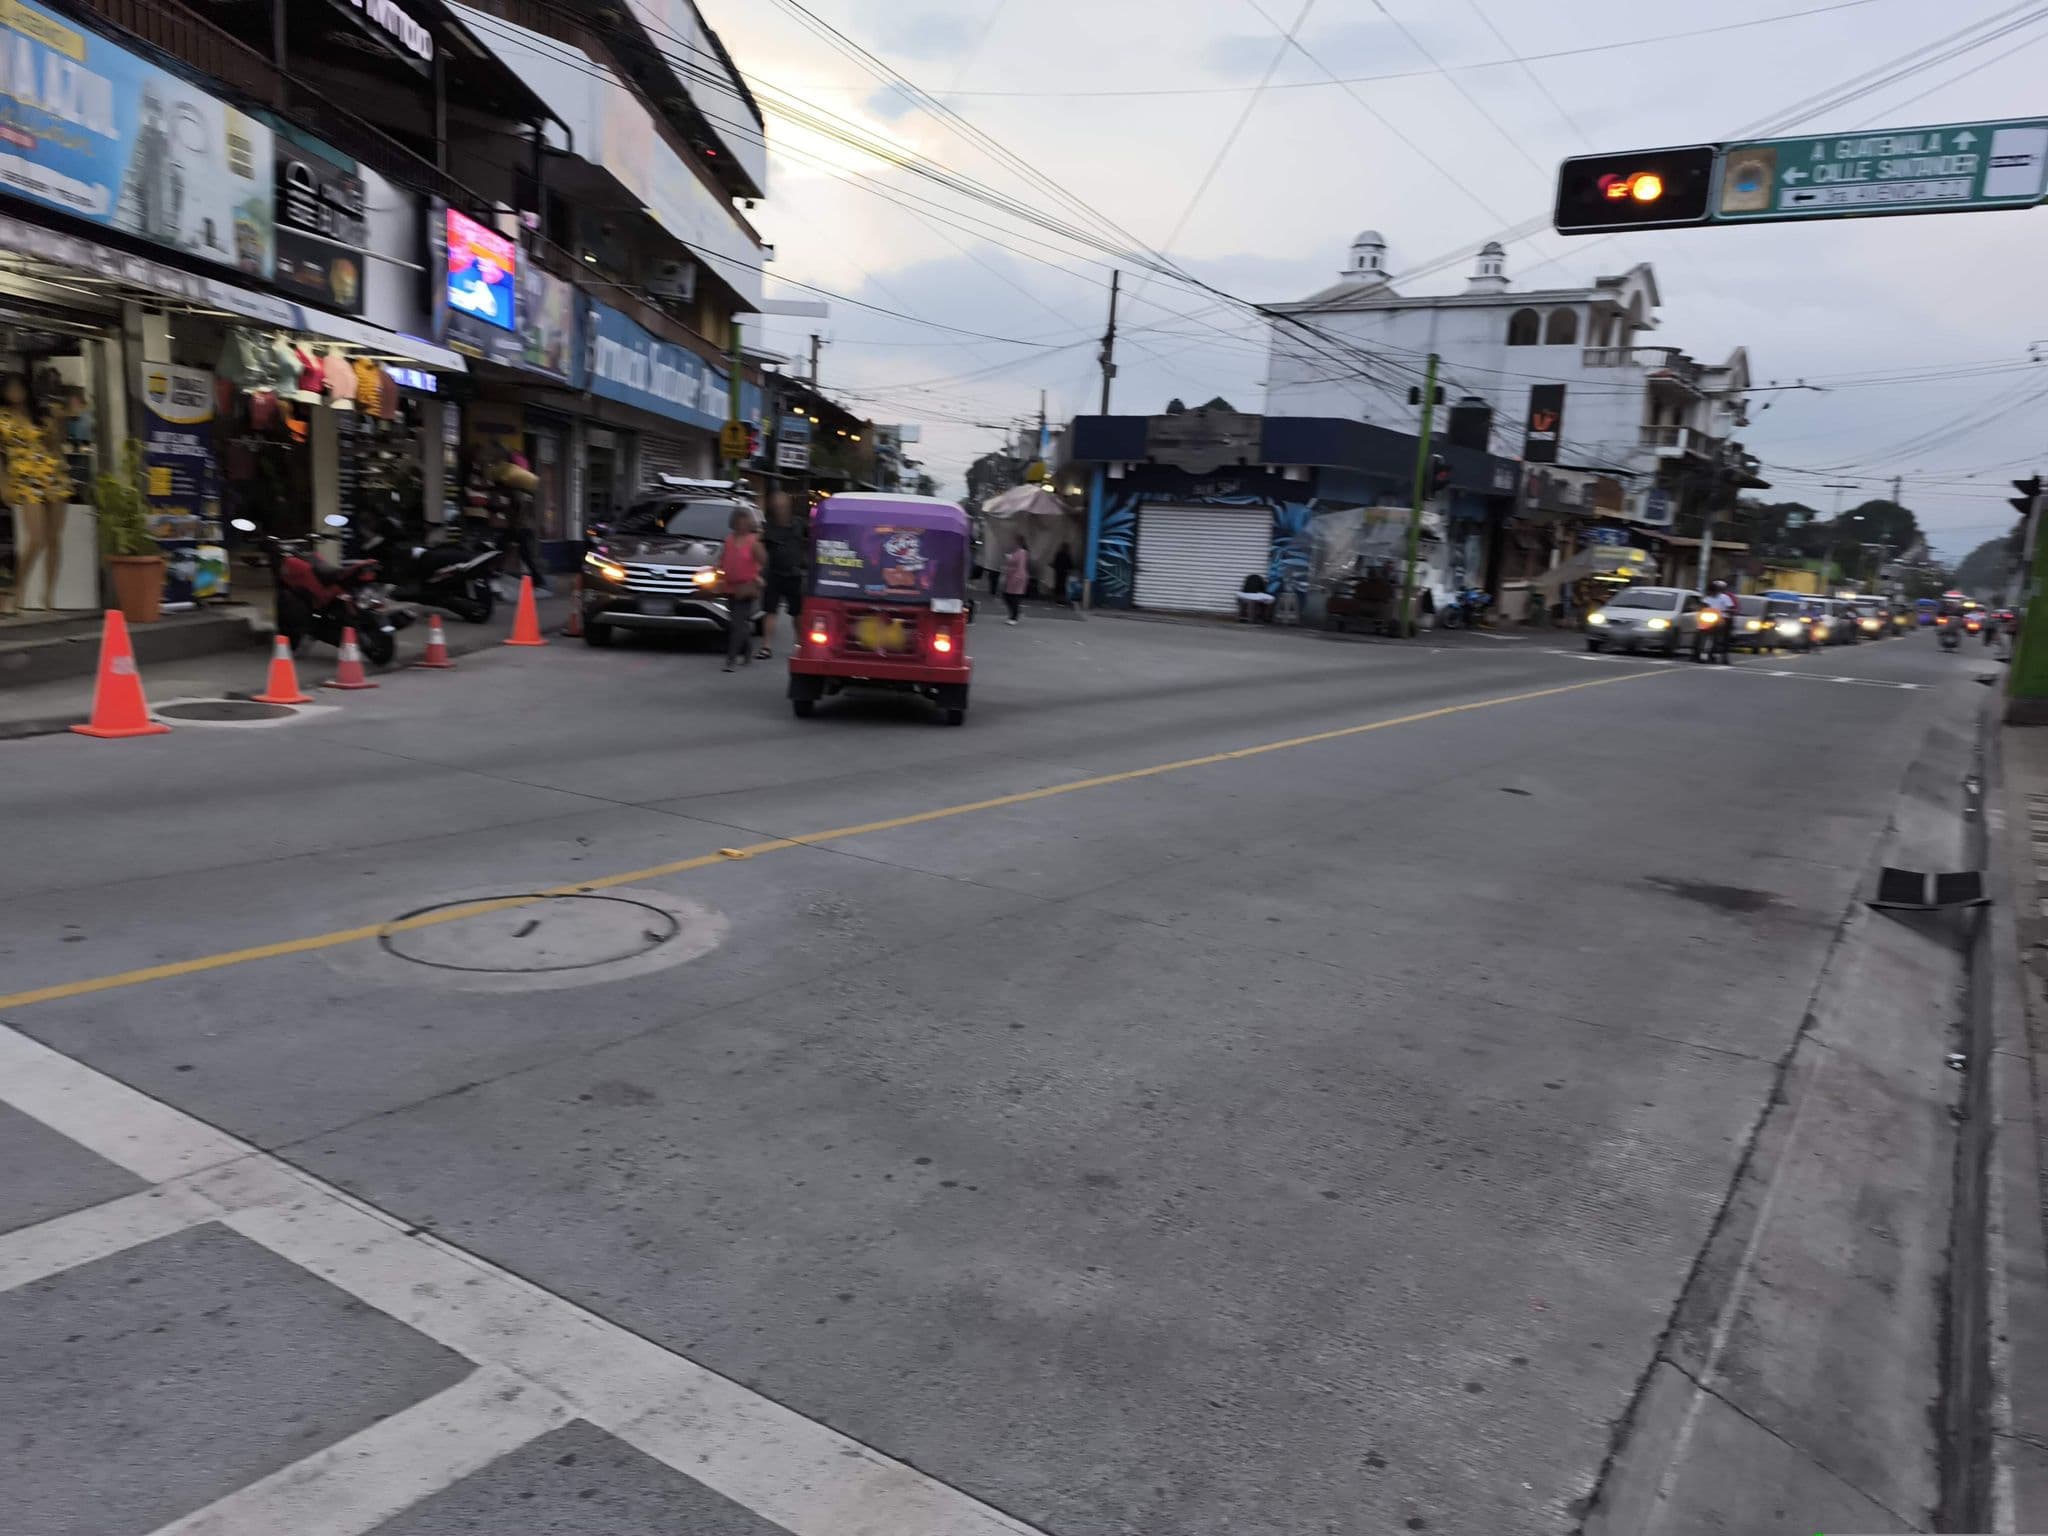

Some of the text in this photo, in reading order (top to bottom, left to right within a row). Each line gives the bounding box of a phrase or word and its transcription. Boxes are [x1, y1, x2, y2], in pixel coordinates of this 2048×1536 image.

[1810, 133, 1942, 161] A GUATEMALA
[1812, 161, 1873, 183] CALLE
[1876, 153, 1980, 179] SANTANDER
